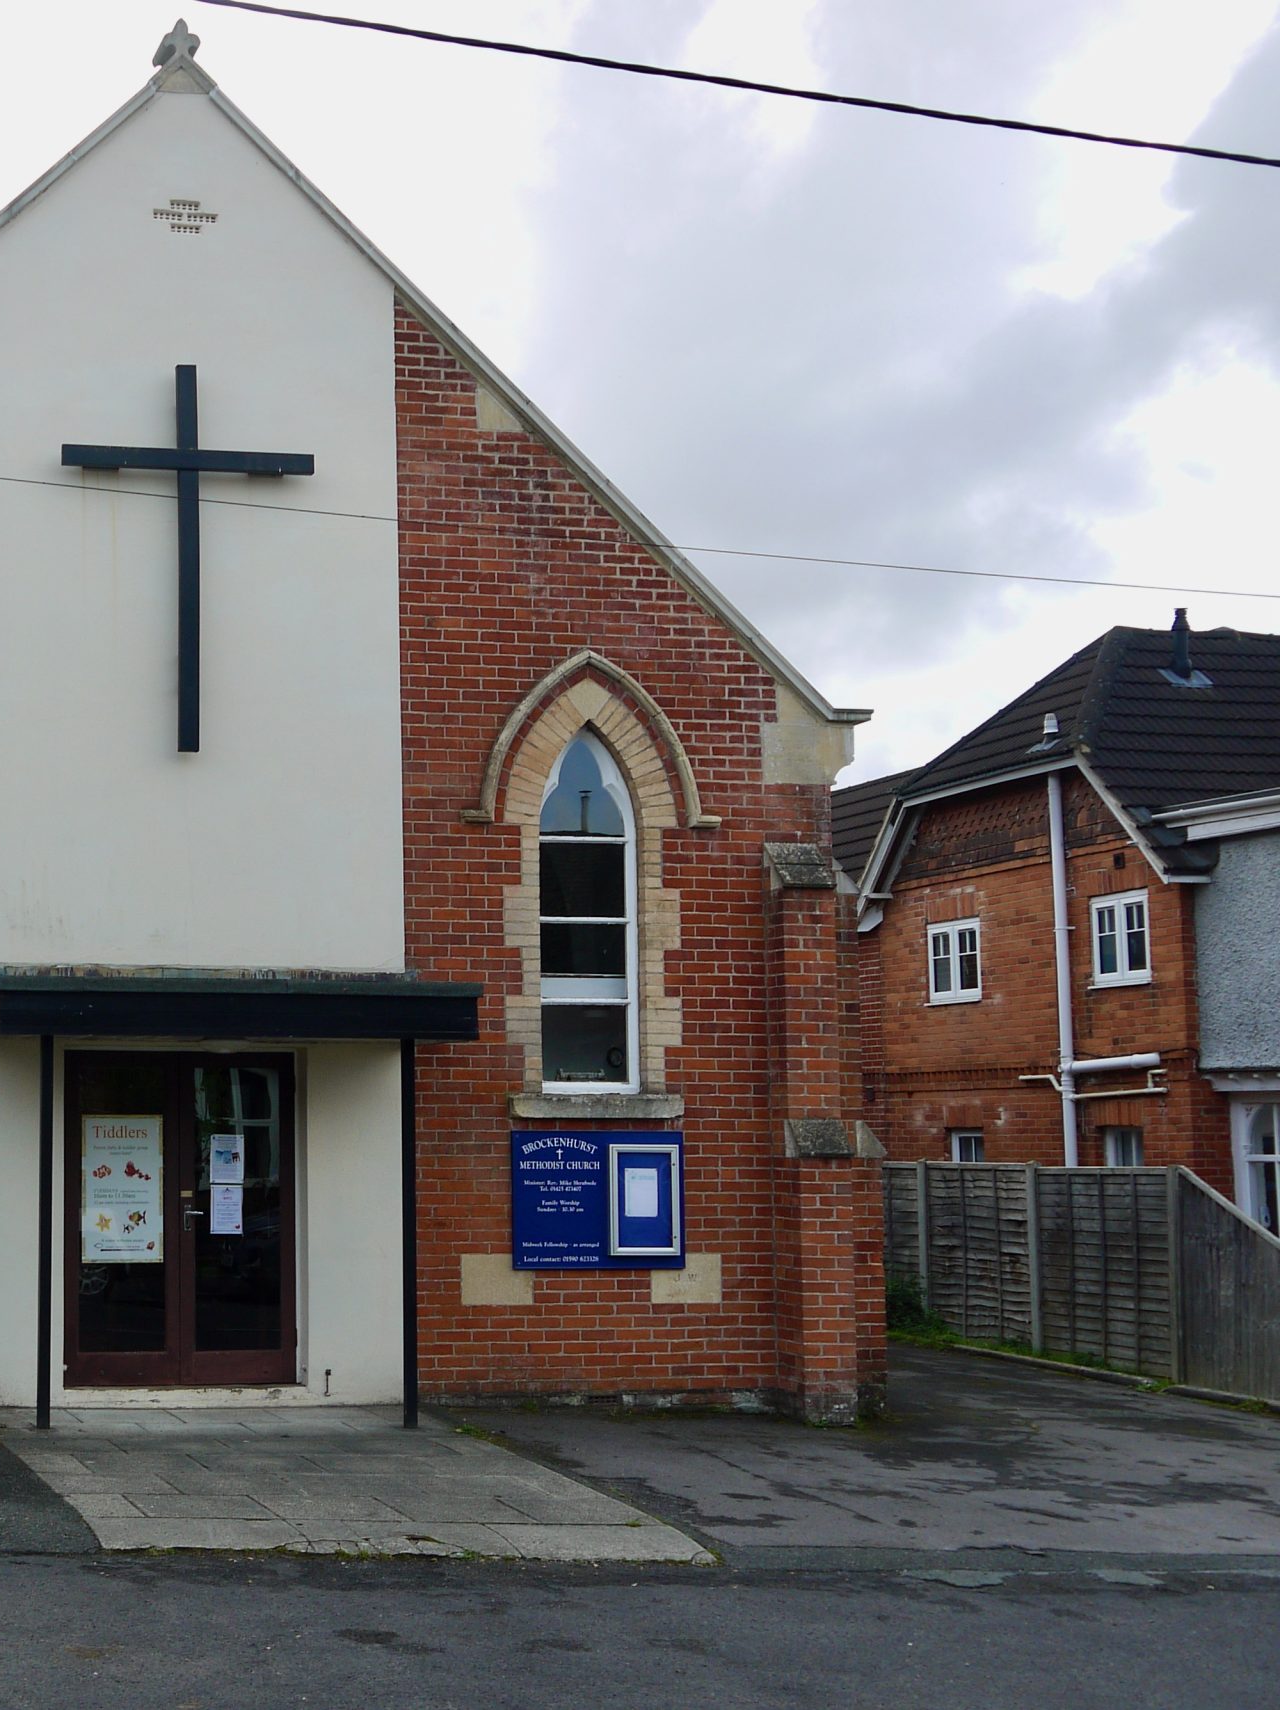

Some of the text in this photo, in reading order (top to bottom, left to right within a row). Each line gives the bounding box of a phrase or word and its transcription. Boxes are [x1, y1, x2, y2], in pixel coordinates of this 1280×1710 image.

[92, 1125, 149, 1139] Tiddlers
[521, 1137, 598, 1155] BROCKENHURST
[520, 1161, 600, 1170] METHODIST CHURCH
